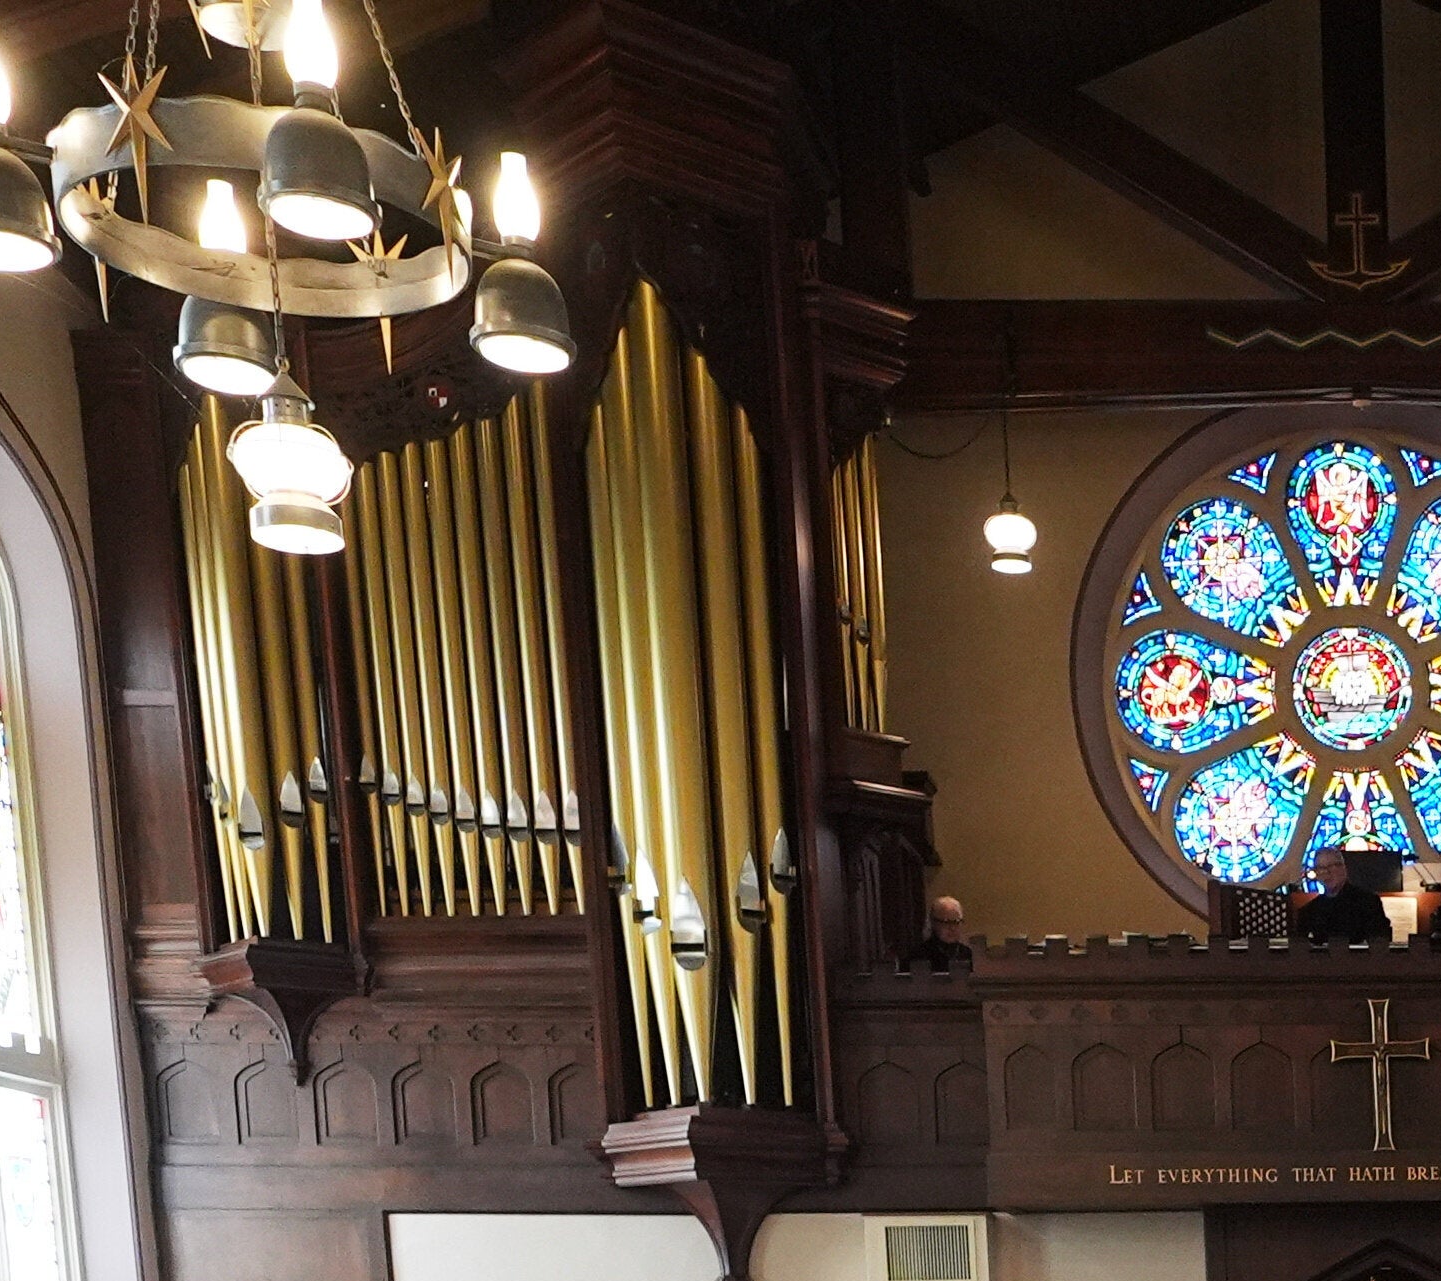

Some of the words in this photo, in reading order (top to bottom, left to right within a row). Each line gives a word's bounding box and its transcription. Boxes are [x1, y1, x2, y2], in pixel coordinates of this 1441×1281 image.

[1158, 1167, 1279, 1184] EVERYTHING
[1291, 1166, 1338, 1183] THAT
[1348, 1165, 1396, 1182] HATH
